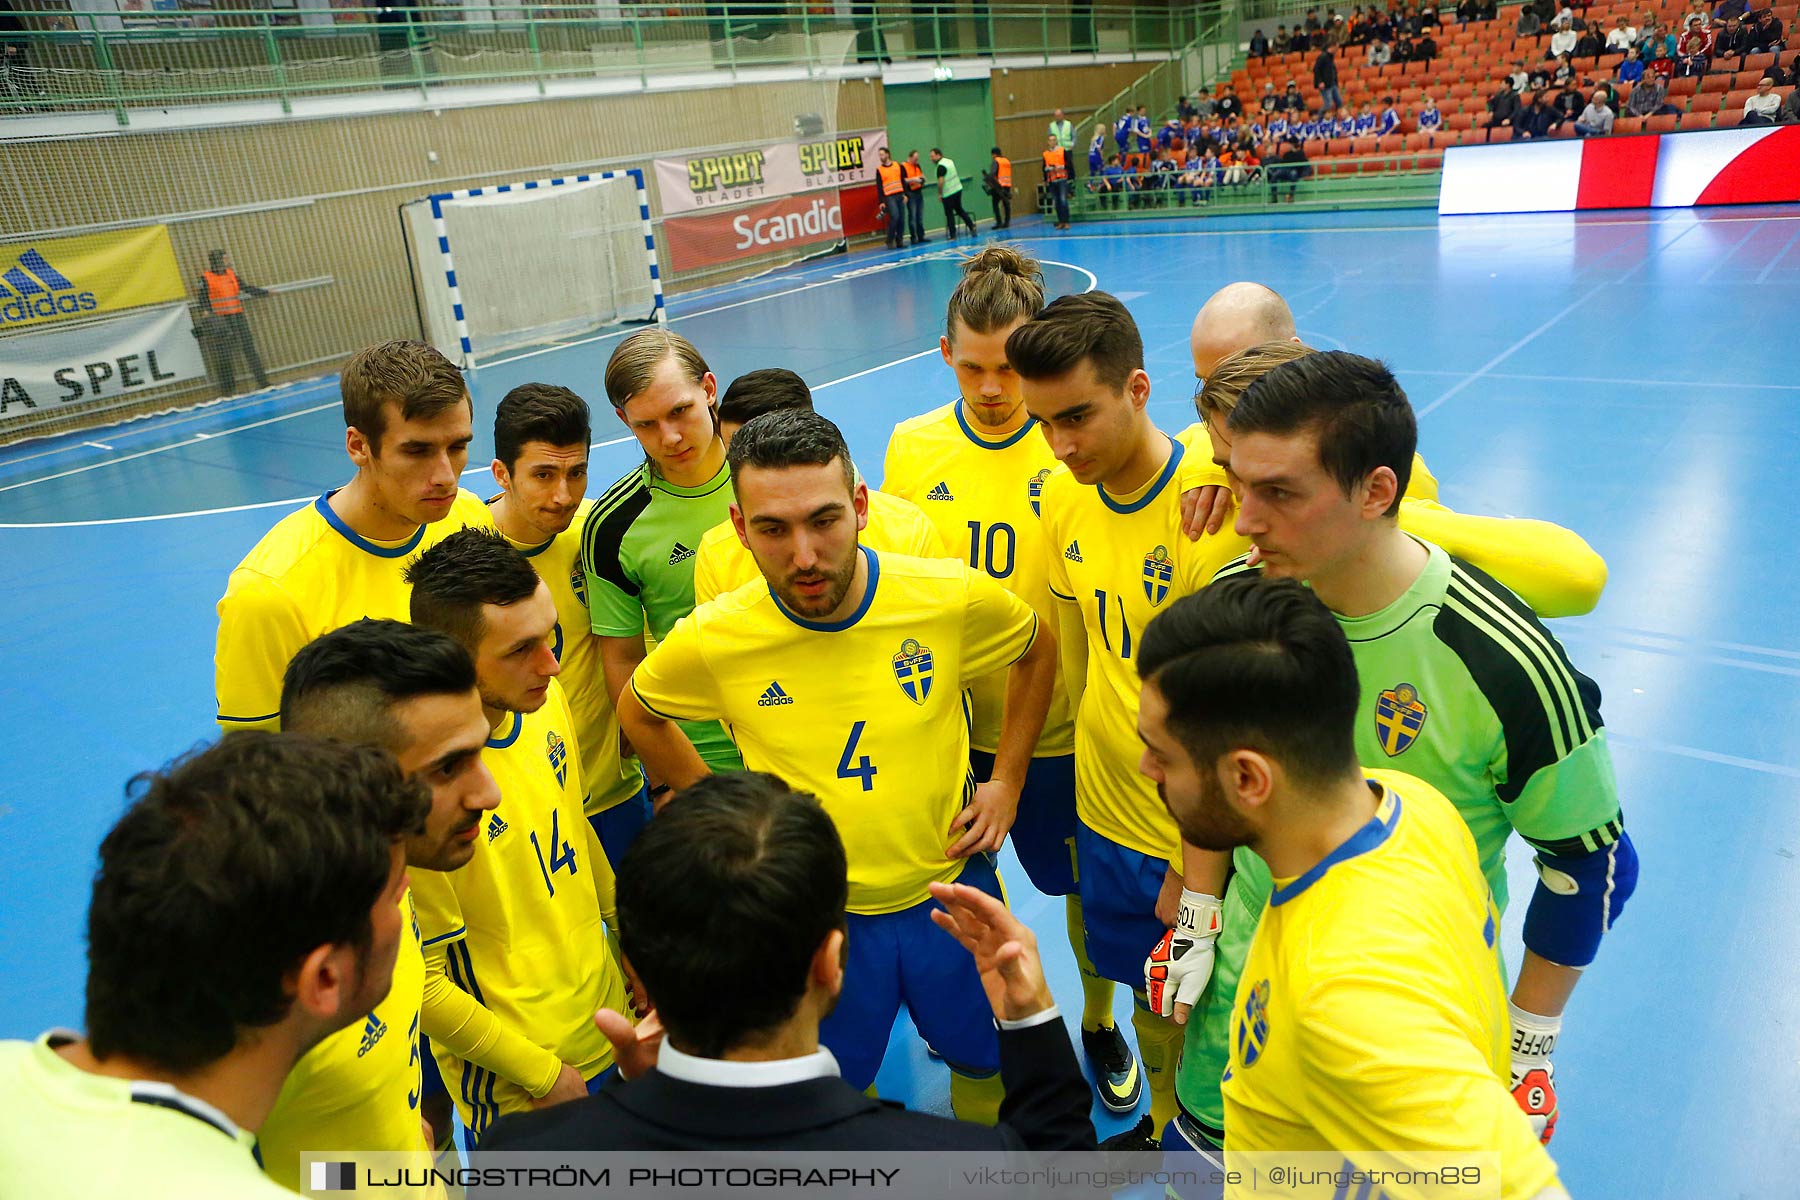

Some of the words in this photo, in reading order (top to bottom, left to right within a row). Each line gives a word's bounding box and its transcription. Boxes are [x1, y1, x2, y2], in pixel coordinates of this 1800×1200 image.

[687, 150, 766, 193] SPORT
[799, 136, 865, 176] SPORT
[695, 186, 764, 205] BLADET
[806, 170, 865, 187] BLADET
[733, 199, 841, 250] Scandic
[0, 291, 97, 323] didas
[54, 350, 175, 402] SPEL
[927, 492, 954, 501] adidas
[668, 549, 695, 565] adidas
[967, 520, 1016, 579] 10
[1065, 552, 1083, 563] adidas
[1094, 588, 1131, 659] 11
[757, 695, 793, 707] adidas
[836, 720, 877, 792] 4
[530, 808, 577, 898] 14
[358, 1022, 387, 1058] adidas
